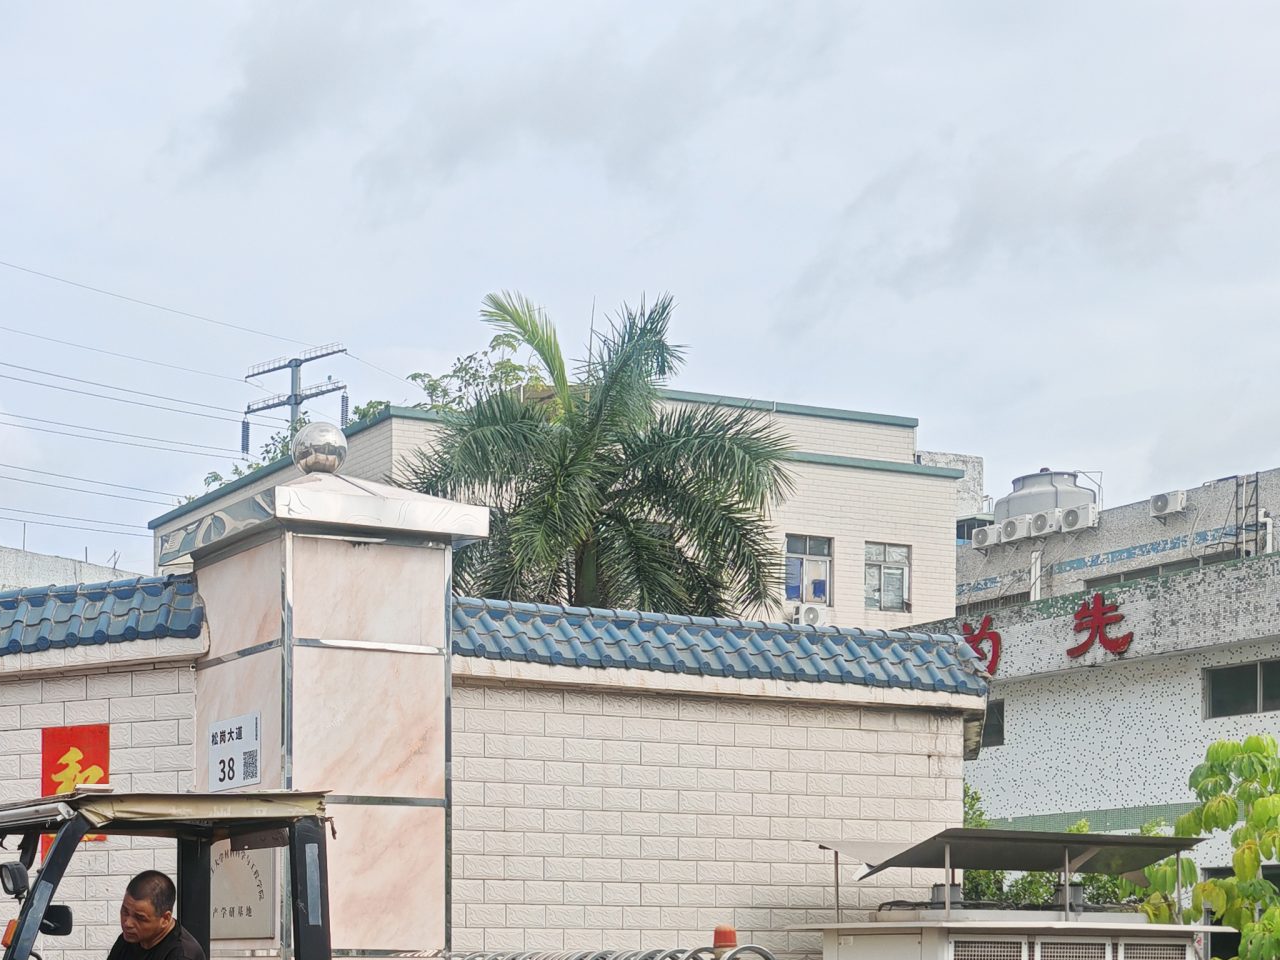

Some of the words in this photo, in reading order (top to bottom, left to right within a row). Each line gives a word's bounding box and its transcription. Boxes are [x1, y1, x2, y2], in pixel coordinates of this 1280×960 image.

[211, 726, 243, 746] 松岗大道
[218, 757, 236, 783] 38
[212, 905, 253, 919] 产学研基地
